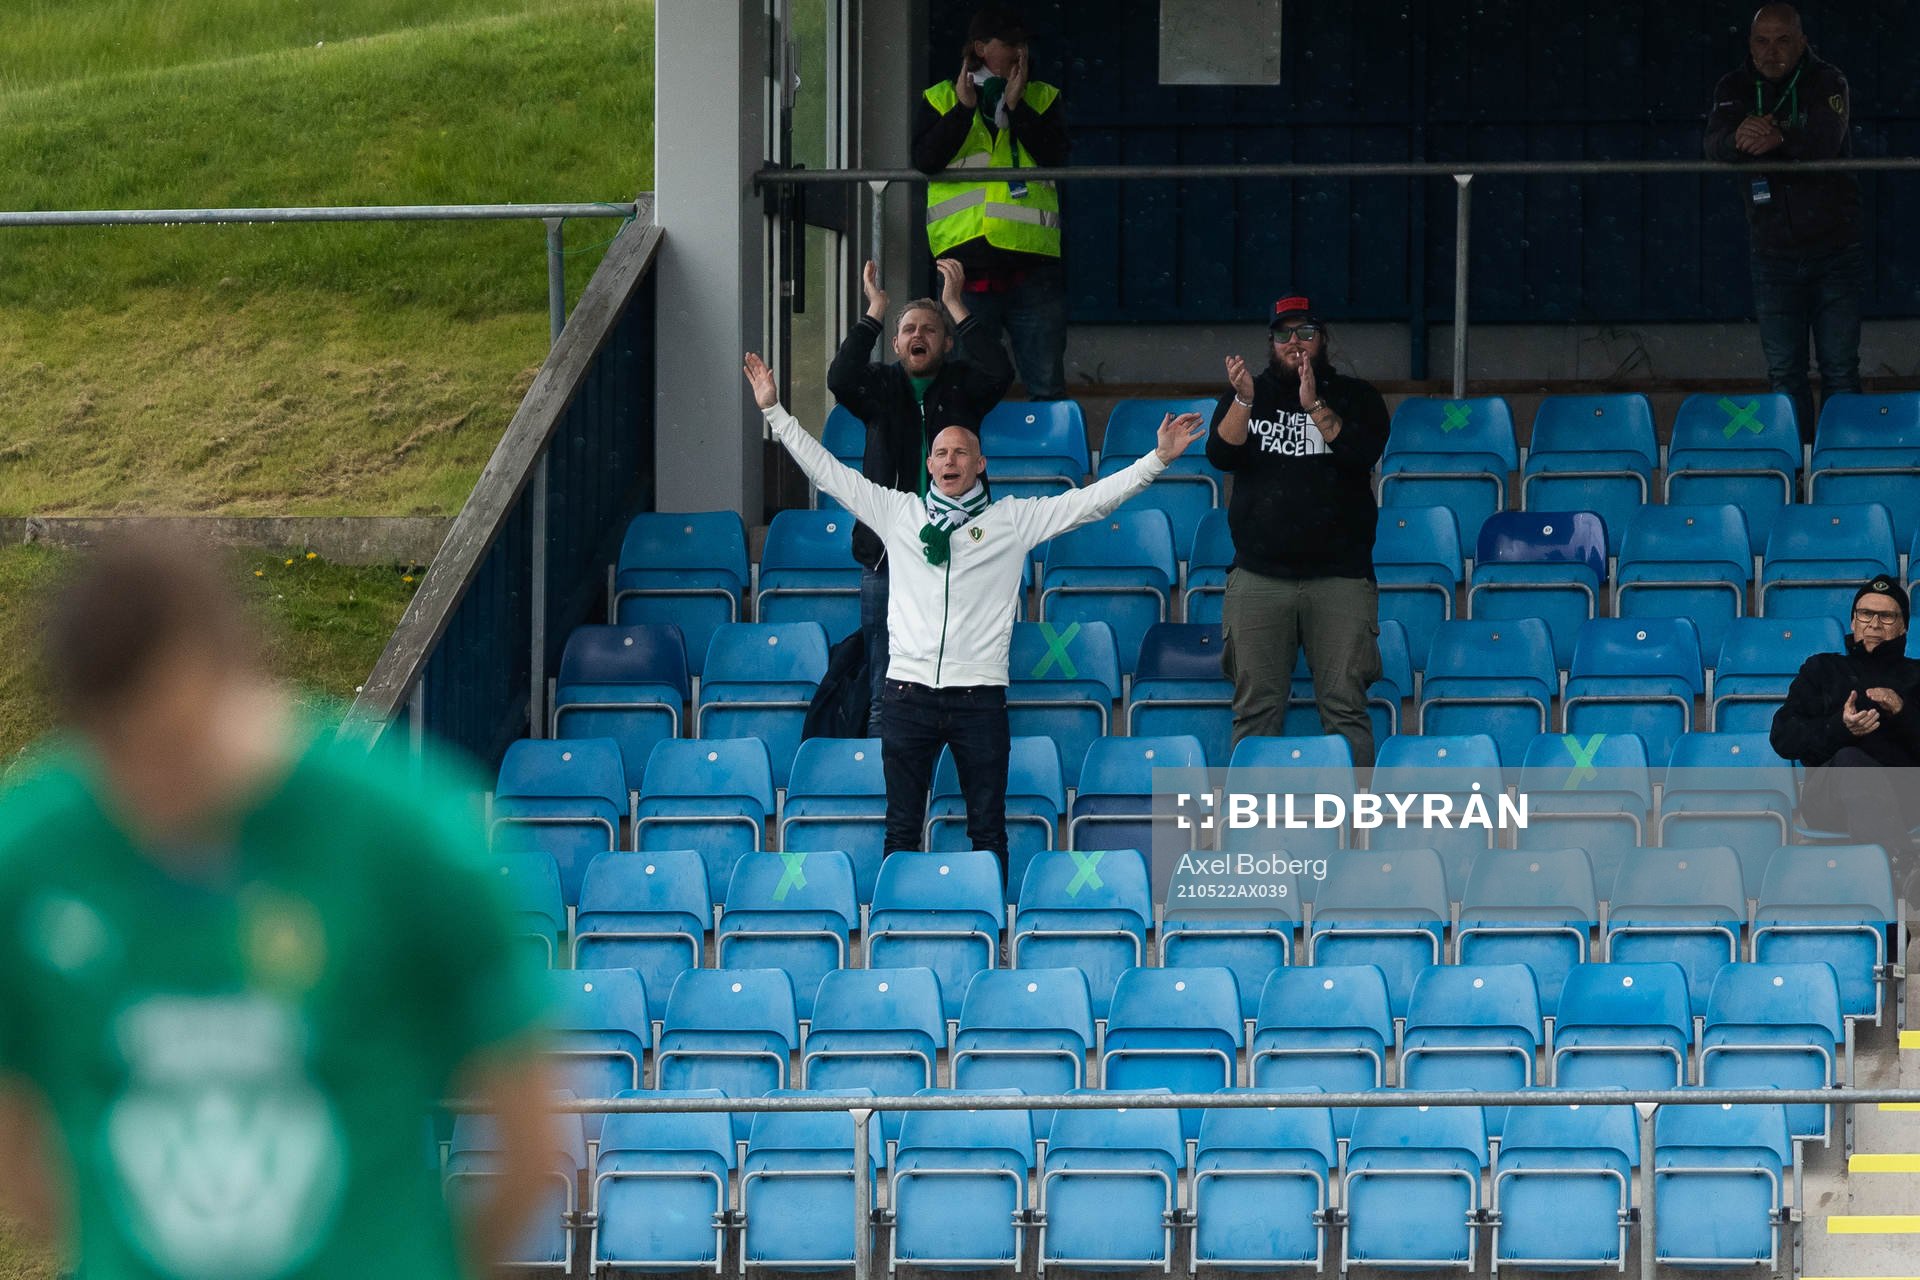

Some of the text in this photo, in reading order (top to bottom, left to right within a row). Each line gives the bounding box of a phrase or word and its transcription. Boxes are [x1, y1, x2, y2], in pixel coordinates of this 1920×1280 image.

[1276, 409, 1307, 426] THE
[1247, 418, 1305, 442] NORTH
[1260, 435, 1305, 457] FACE
